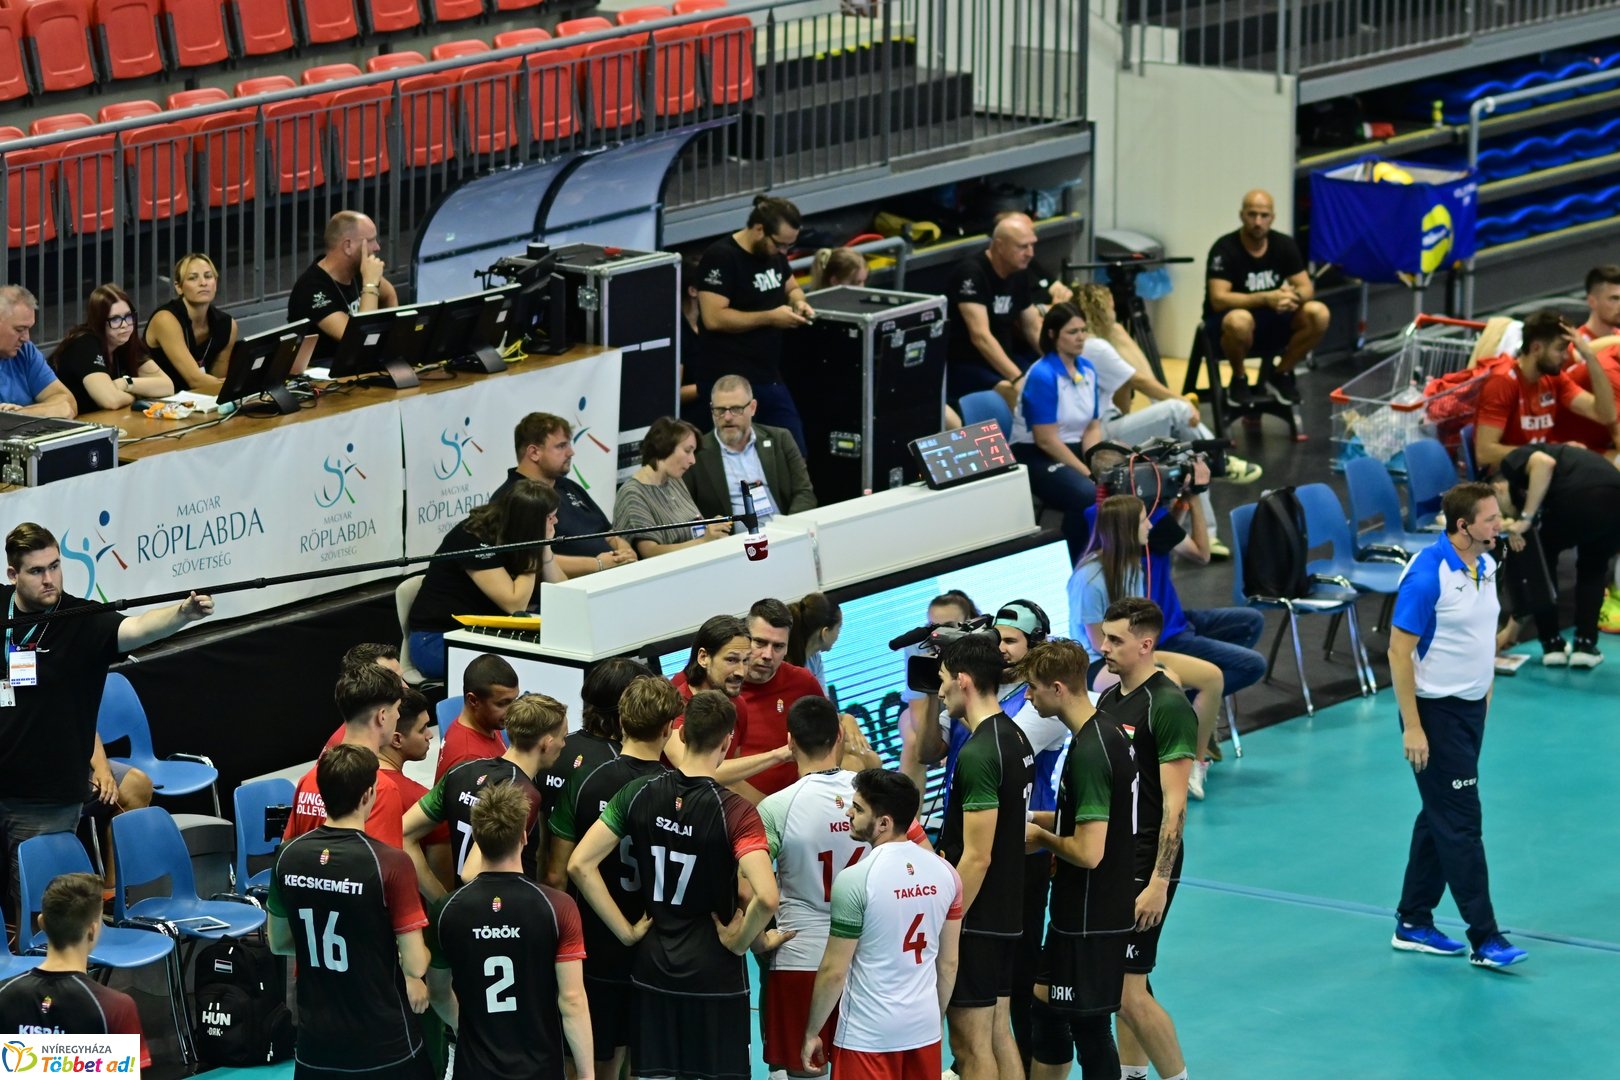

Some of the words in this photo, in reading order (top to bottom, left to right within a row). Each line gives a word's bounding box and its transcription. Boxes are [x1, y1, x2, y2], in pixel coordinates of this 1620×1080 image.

[441, 484, 470, 497] MAGYAR
[177, 495, 221, 517] MAGYAR
[323, 511, 353, 525] MAGYAR
[137, 507, 265, 564] RÖPLABDA
[300, 518, 377, 554] RÖPLABDA
[172, 551, 232, 578] SZÖVETSÉG
[320, 546, 358, 562] SZÖVETSÉG
[284, 874, 364, 895] KECSKEMÉTI
[651, 845, 698, 905] 17
[893, 884, 937, 899] TAKÁCS
[298, 907, 349, 973] 16
[472, 925, 521, 939] TÖRÖK
[902, 912, 928, 965] 4
[483, 954, 518, 1014] 2
[202, 1010, 231, 1026] HUN
